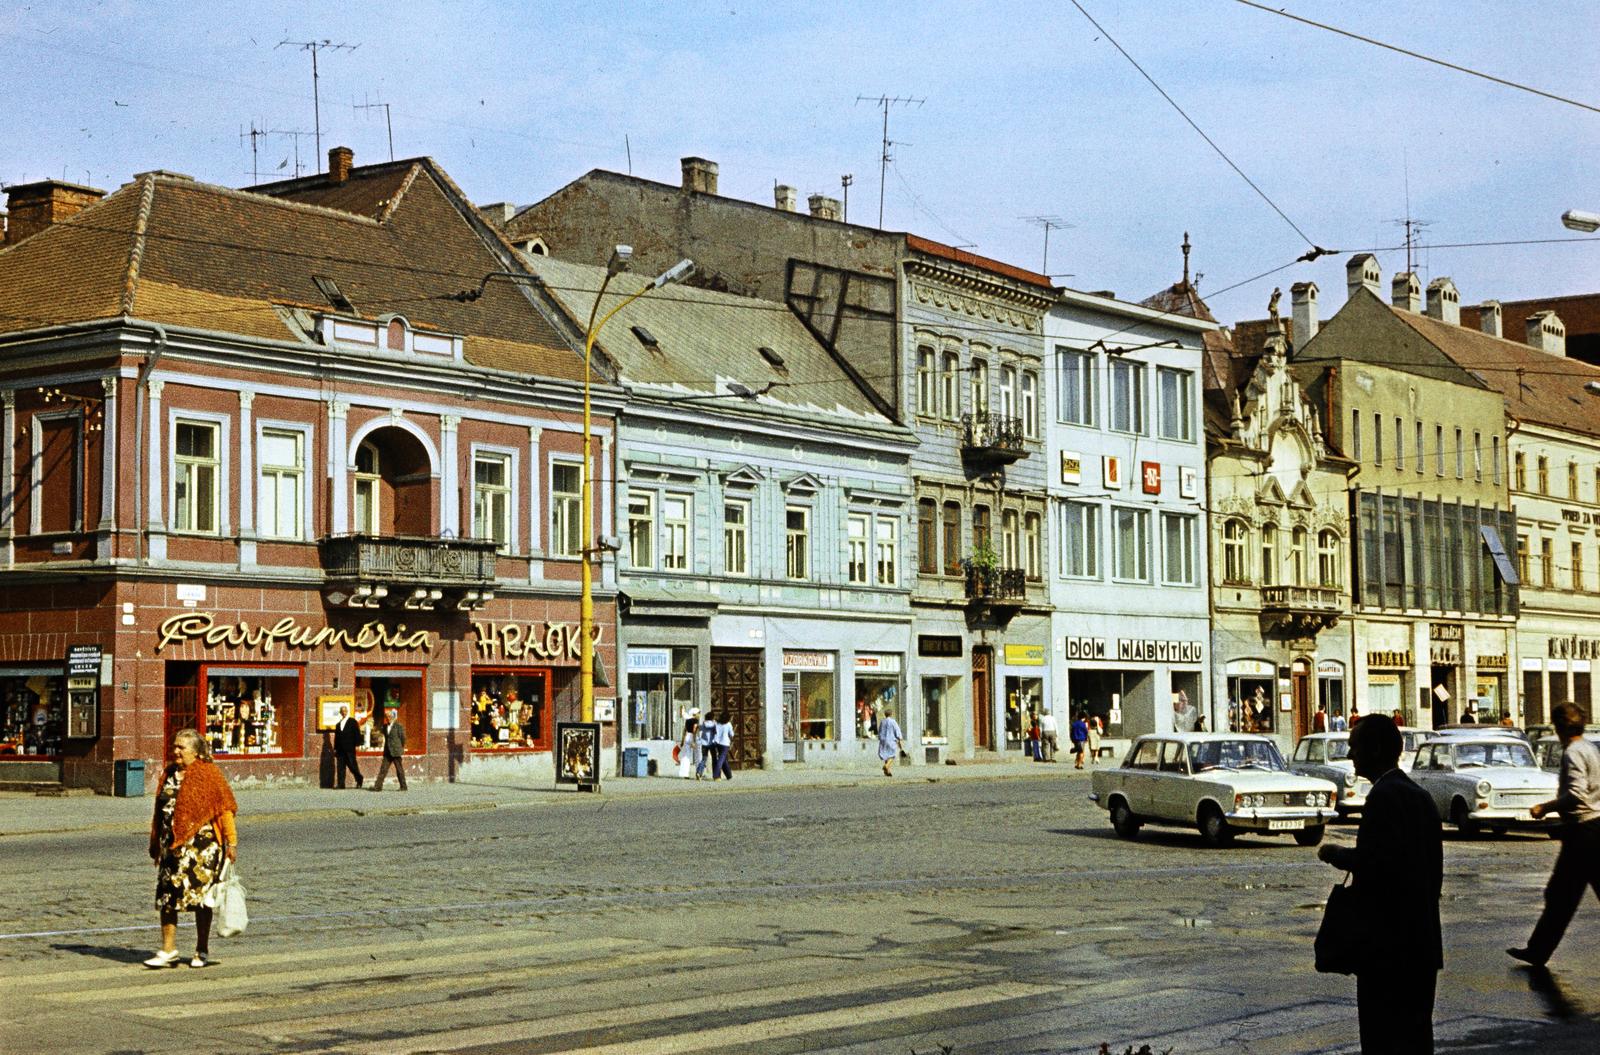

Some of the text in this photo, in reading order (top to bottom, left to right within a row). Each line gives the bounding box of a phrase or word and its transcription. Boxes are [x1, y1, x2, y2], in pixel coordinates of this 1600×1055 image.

[158, 611, 434, 652] Parfuméria
[1070, 640, 1202, 660] DOM NÁBYTKU
